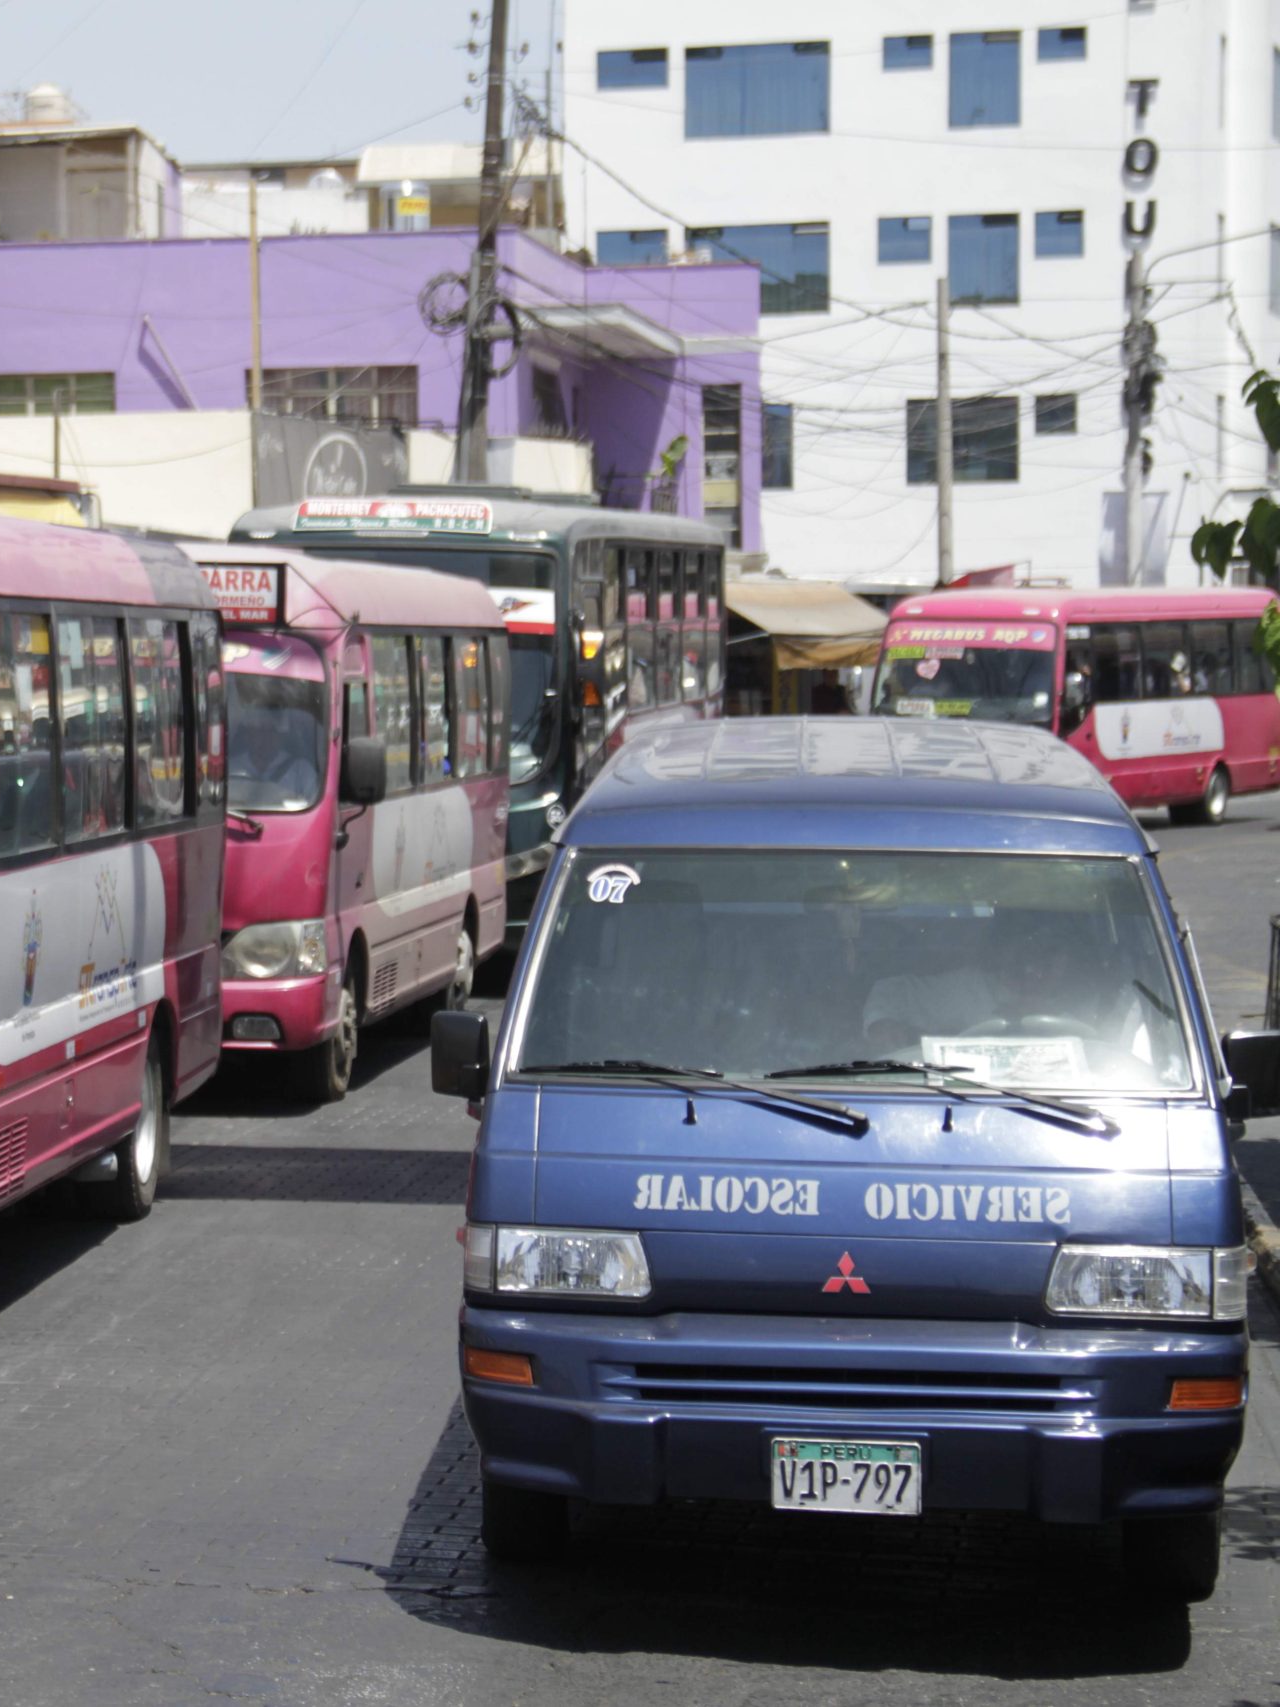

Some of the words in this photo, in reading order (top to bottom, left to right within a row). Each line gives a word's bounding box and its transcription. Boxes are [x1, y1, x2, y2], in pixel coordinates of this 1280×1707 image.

[306, 501, 372, 517] MONTERREY
[415, 502, 485, 519] PACHACUTEC
[909, 628, 987, 642] MEGABUS
[992, 628, 1029, 644] AQP
[589, 874, 633, 904] 07
[820, 1443, 872, 1460] PERU
[779, 1458, 913, 1506] V1P-797
